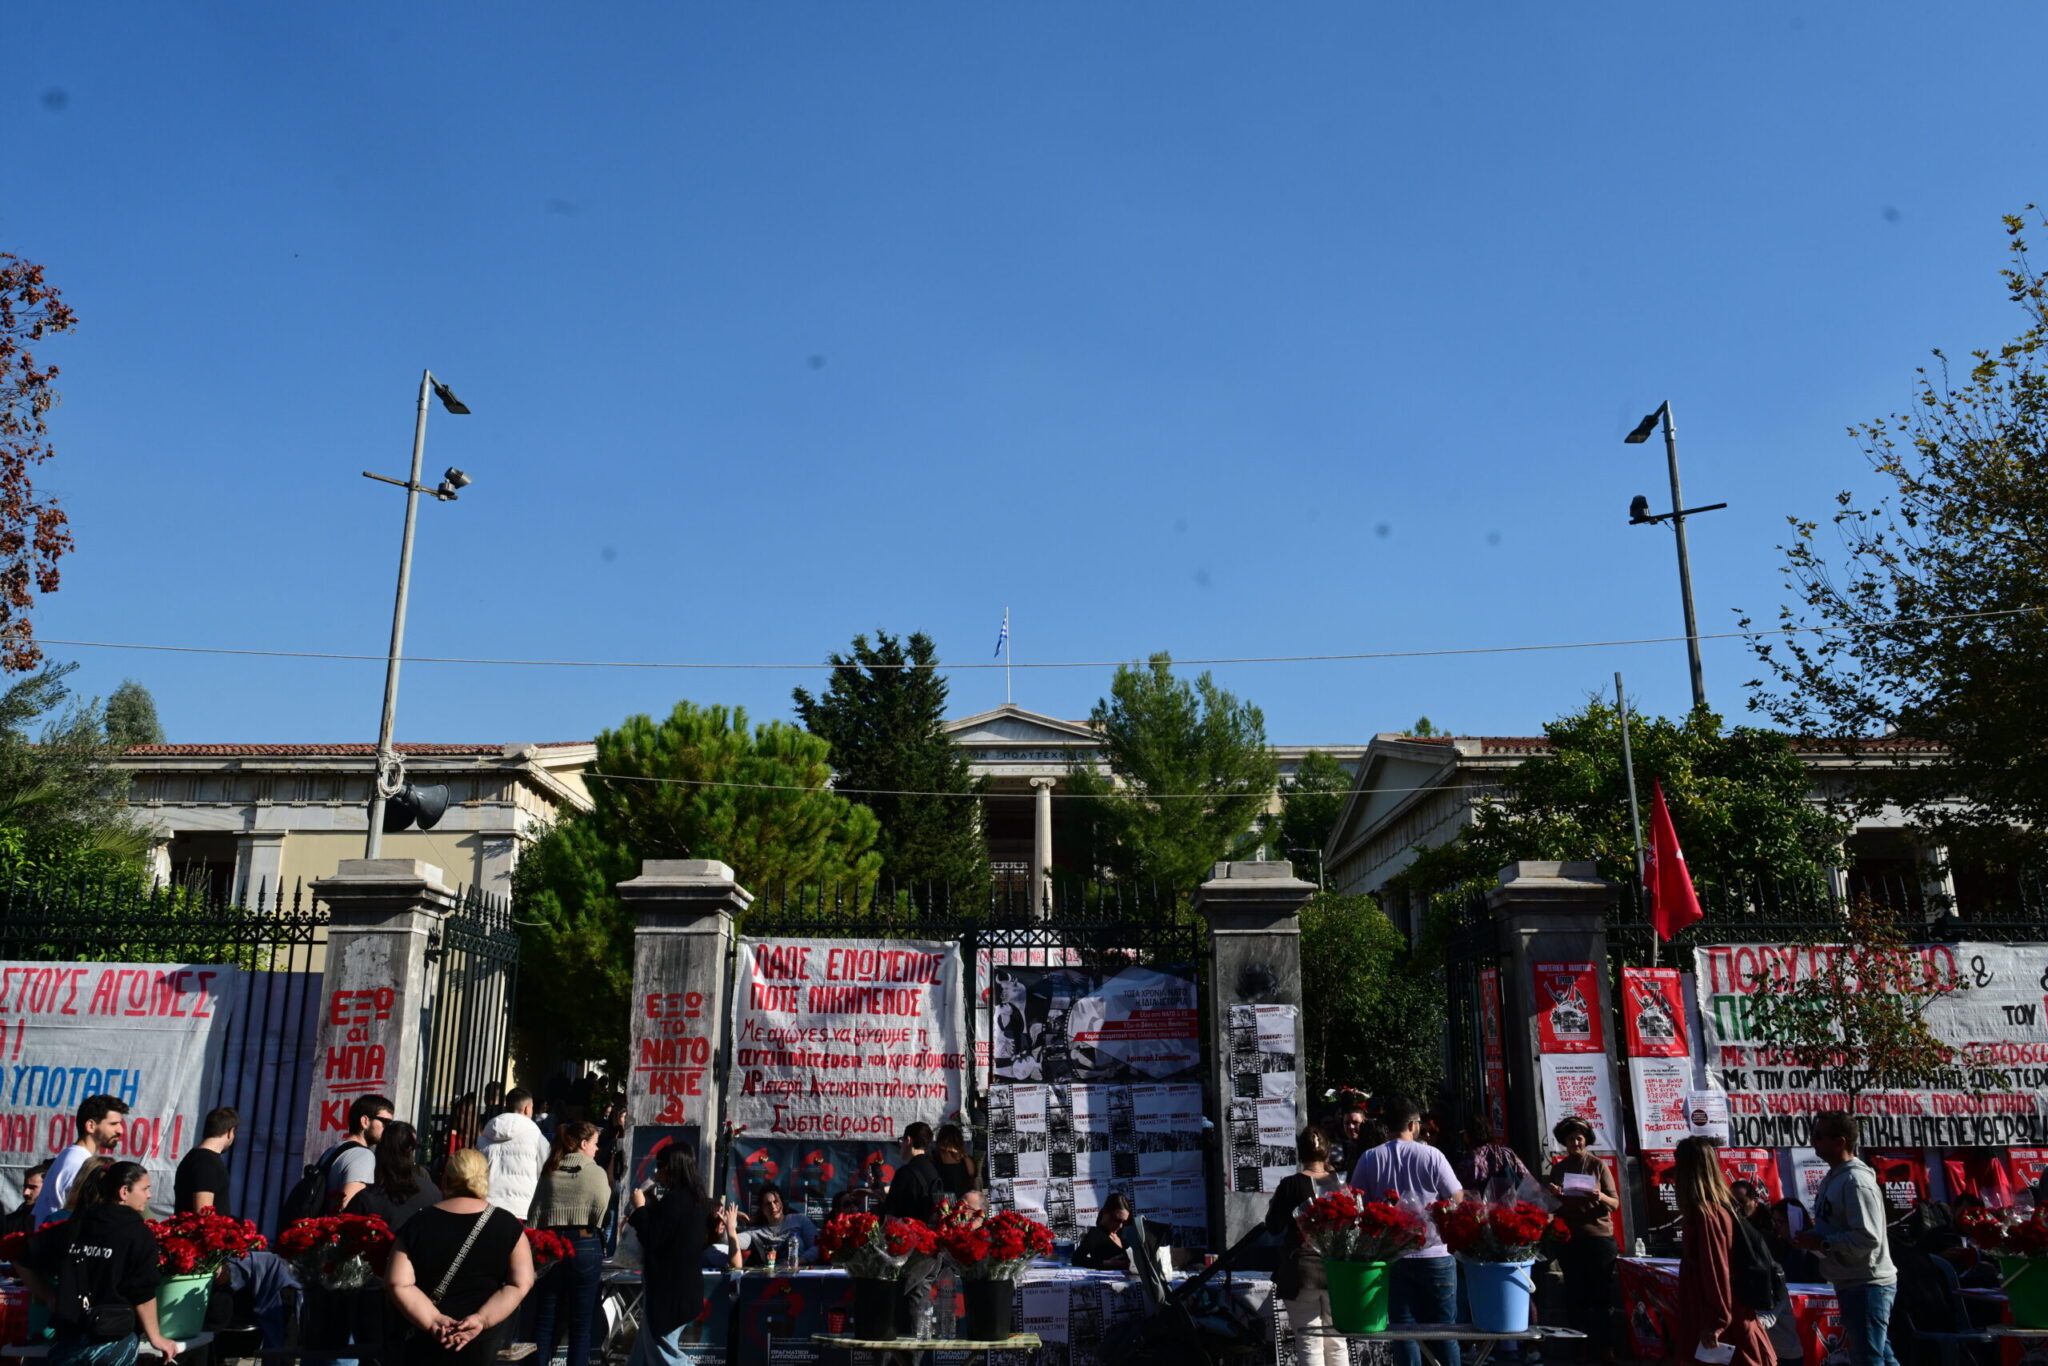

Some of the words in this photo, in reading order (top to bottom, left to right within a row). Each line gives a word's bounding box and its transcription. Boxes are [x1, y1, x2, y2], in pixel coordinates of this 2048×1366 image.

[827, 949, 945, 985] ΕΝΩΜΕΝΟΣ
[1971, 955, 1993, 988] &
[0, 968, 88, 1015] ΣΤΟΥΣ
[89, 969, 217, 1018] ΑΓΩΝΕΣ
[331, 987, 395, 1025] ΕΞΩ
[646, 991, 703, 1018] ΕΞΩ
[750, 983, 800, 1013] ΠΟΤΕ
[808, 986, 922, 1016] ΝΙΚΗΜΕΝΟΣ
[660, 1020, 686, 1035] ΤΟ
[739, 1018, 764, 1042] Με
[833, 1028, 850, 1043] να
[325, 1045, 386, 1079] ΗΠΑ
[642, 1036, 710, 1065] ΝΑΤΟ
[11, 1065, 141, 1108] ΥΠΟΤΑΓΗ
[649, 1071, 702, 1096] ΚΝΕ
[1722, 1069, 1748, 1090] Με
